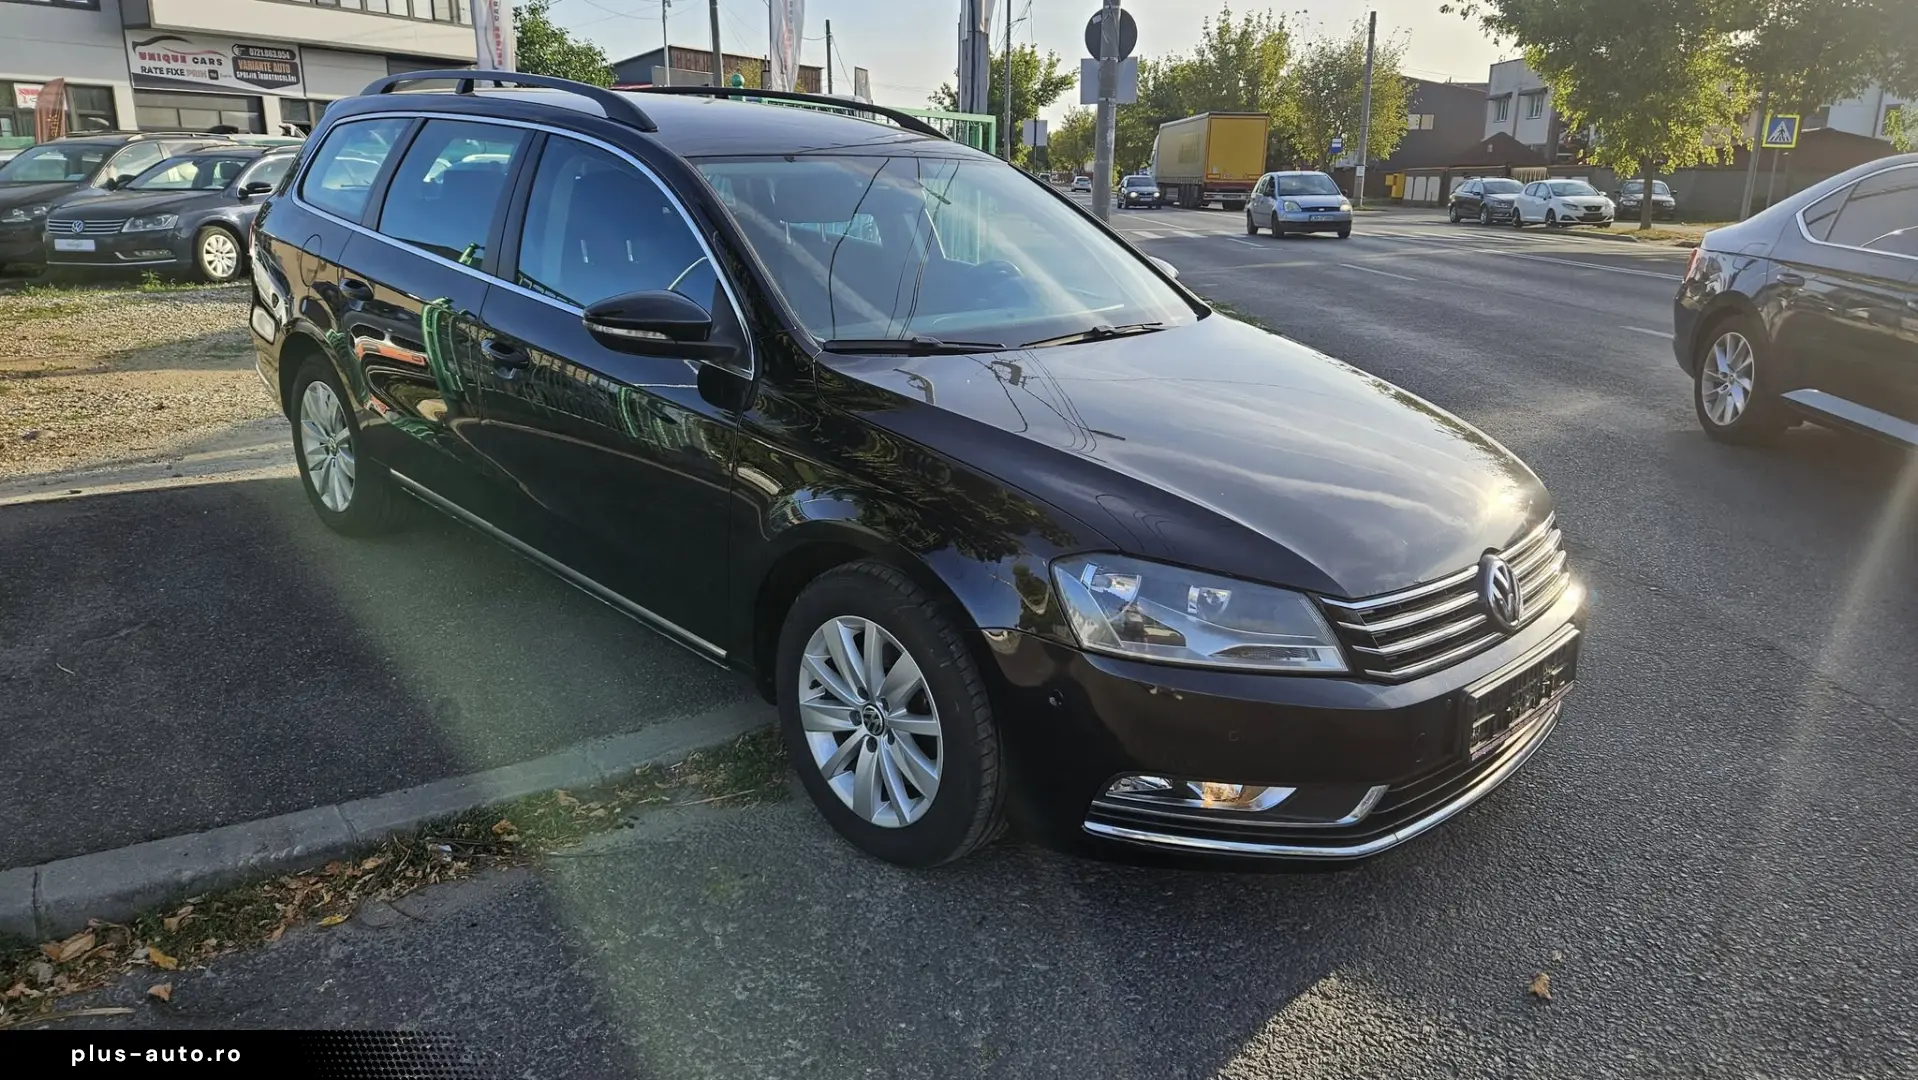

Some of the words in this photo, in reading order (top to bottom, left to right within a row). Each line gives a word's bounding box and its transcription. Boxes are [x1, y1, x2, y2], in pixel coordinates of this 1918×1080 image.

[139, 52, 187, 64] UNIQUE
[192, 57, 223, 66] CARS
[141, 66, 164, 75] RATE
[166, 67, 185, 76] FIXE
[238, 60, 272, 72] VARIANTE
[273, 62, 291, 73] AUTO
